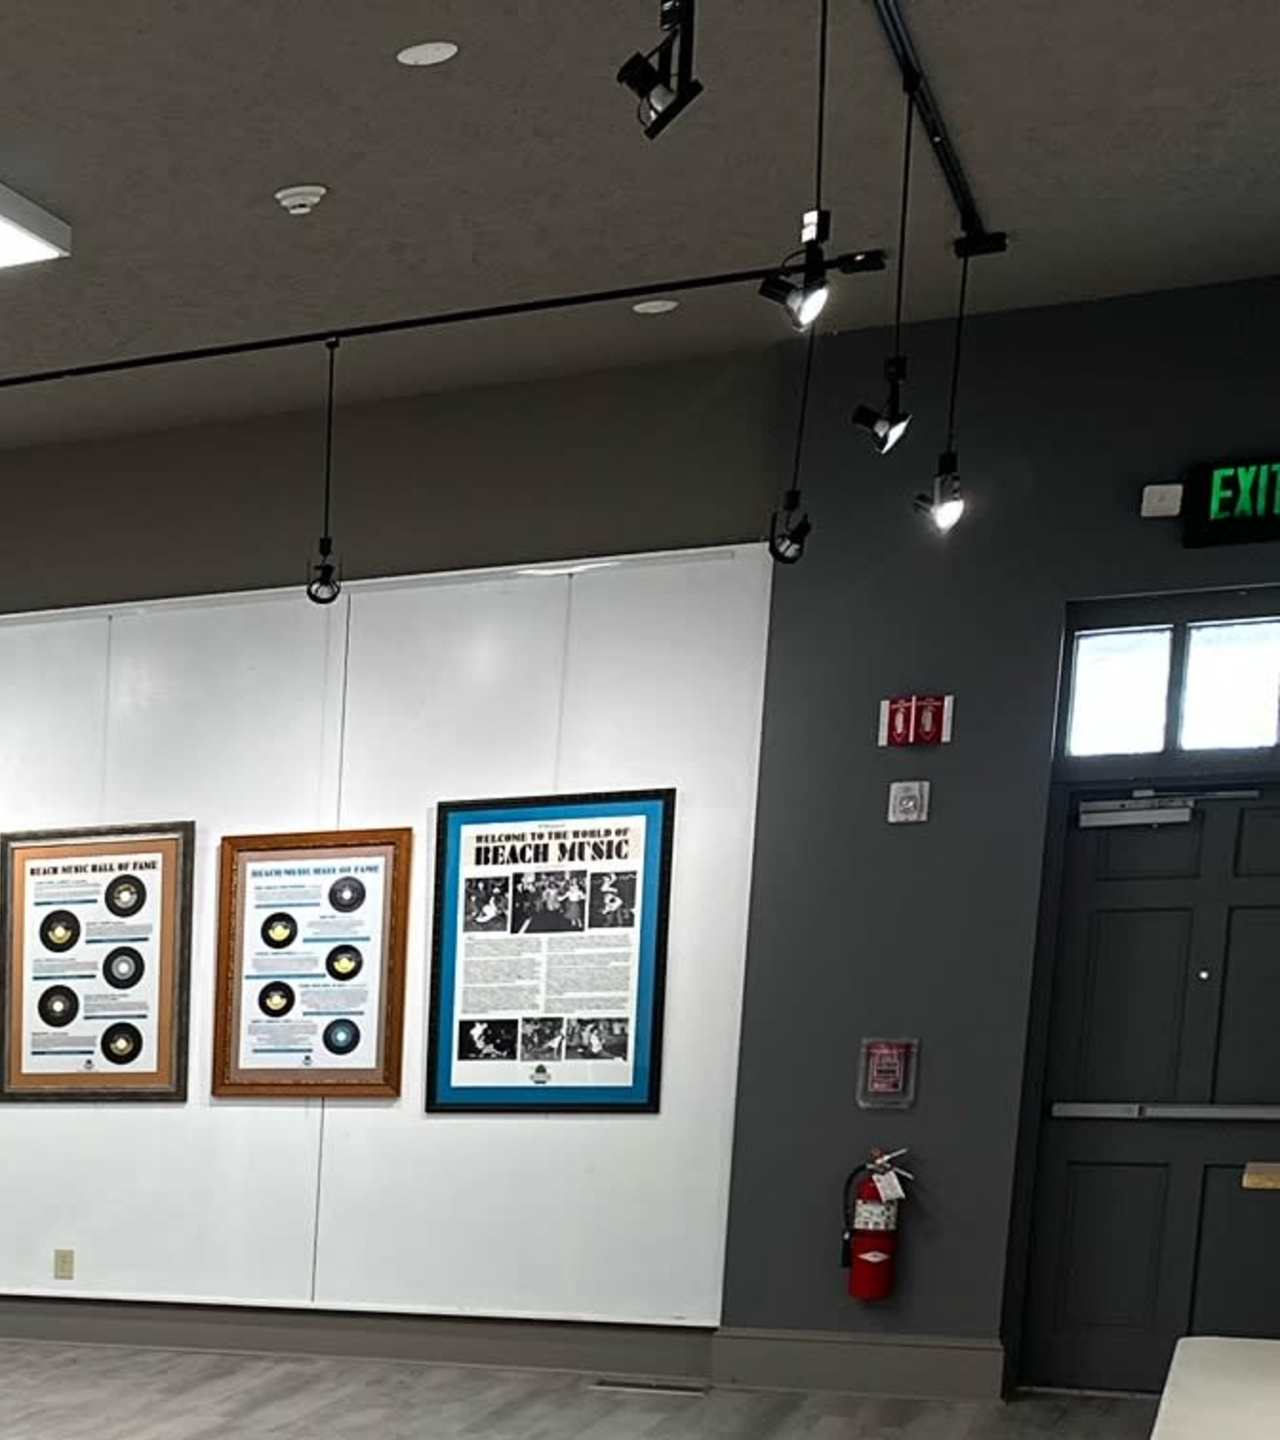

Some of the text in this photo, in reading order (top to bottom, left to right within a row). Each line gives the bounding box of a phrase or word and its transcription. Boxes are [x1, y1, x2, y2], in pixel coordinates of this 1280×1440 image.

[1210, 462, 1280, 520] EXIT
[476, 827, 629, 844] WELCOME TO THE WORLD OF
[475, 839, 629, 865] BEACH MUSIC
[30, 860, 157, 876] BEACH MUSIC HALL OF FAME
